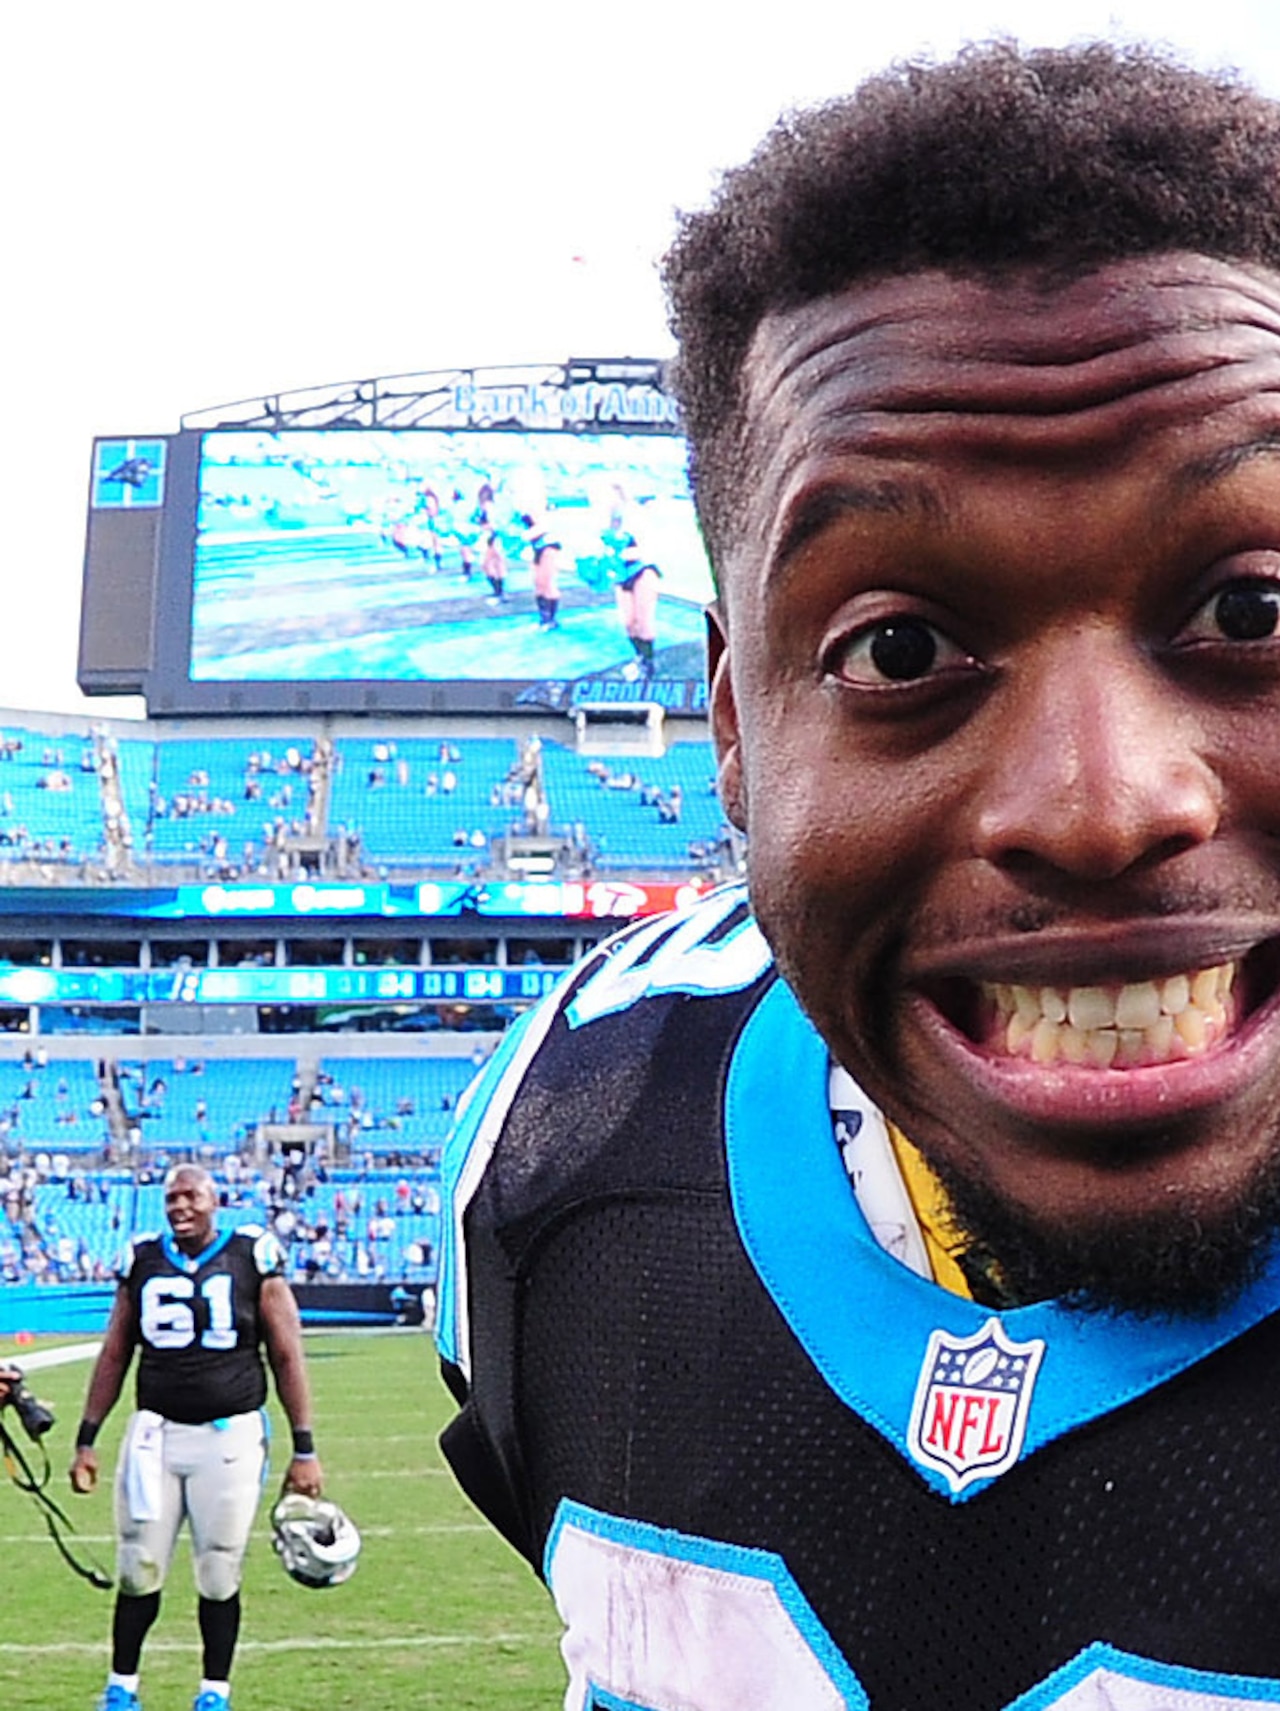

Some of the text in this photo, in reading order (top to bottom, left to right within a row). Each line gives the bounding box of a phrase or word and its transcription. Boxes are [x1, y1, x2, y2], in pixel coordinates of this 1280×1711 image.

[455, 385, 548, 414] Bank
[560, 383, 598, 417] of
[572, 681, 686, 708] CAROLINA
[141, 1274, 238, 1349] 61
[926, 1392, 1003, 1460] NFL
